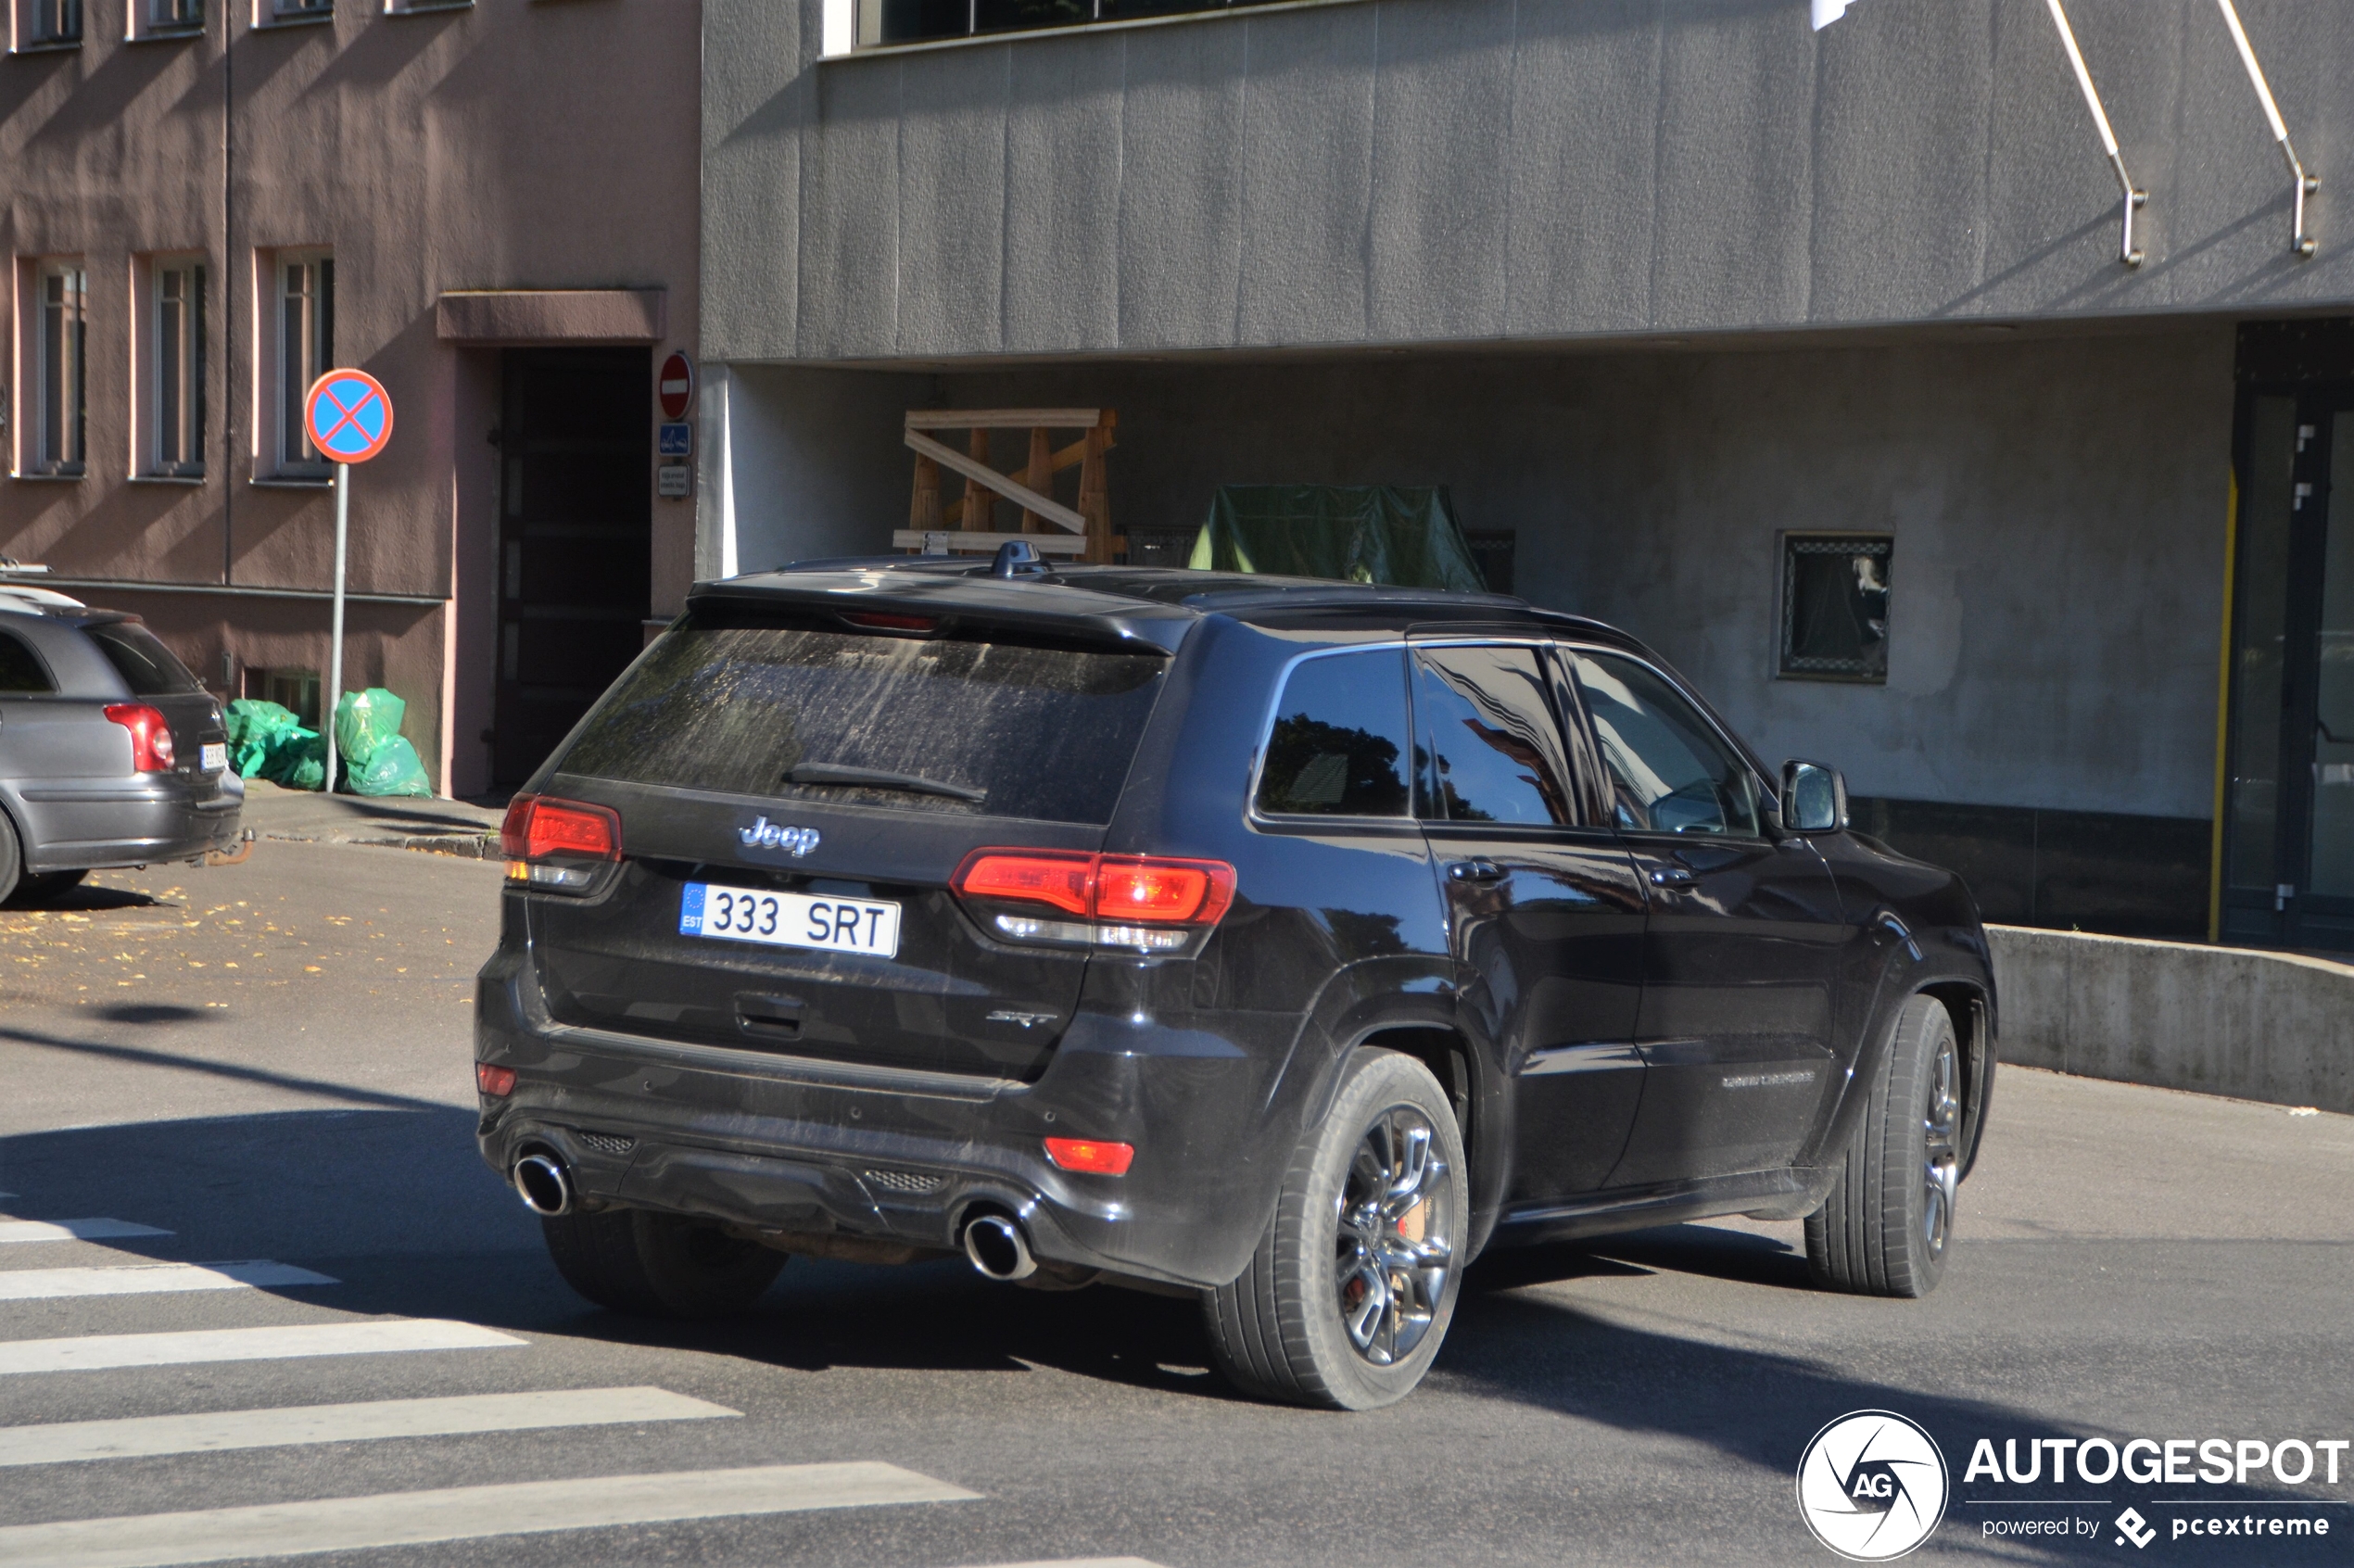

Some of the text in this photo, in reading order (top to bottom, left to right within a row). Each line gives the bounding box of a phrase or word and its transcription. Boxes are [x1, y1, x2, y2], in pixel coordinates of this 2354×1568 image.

[739, 815, 820, 857] Jeep
[682, 915, 703, 929] EST
[714, 891, 885, 947] 333 SRT
